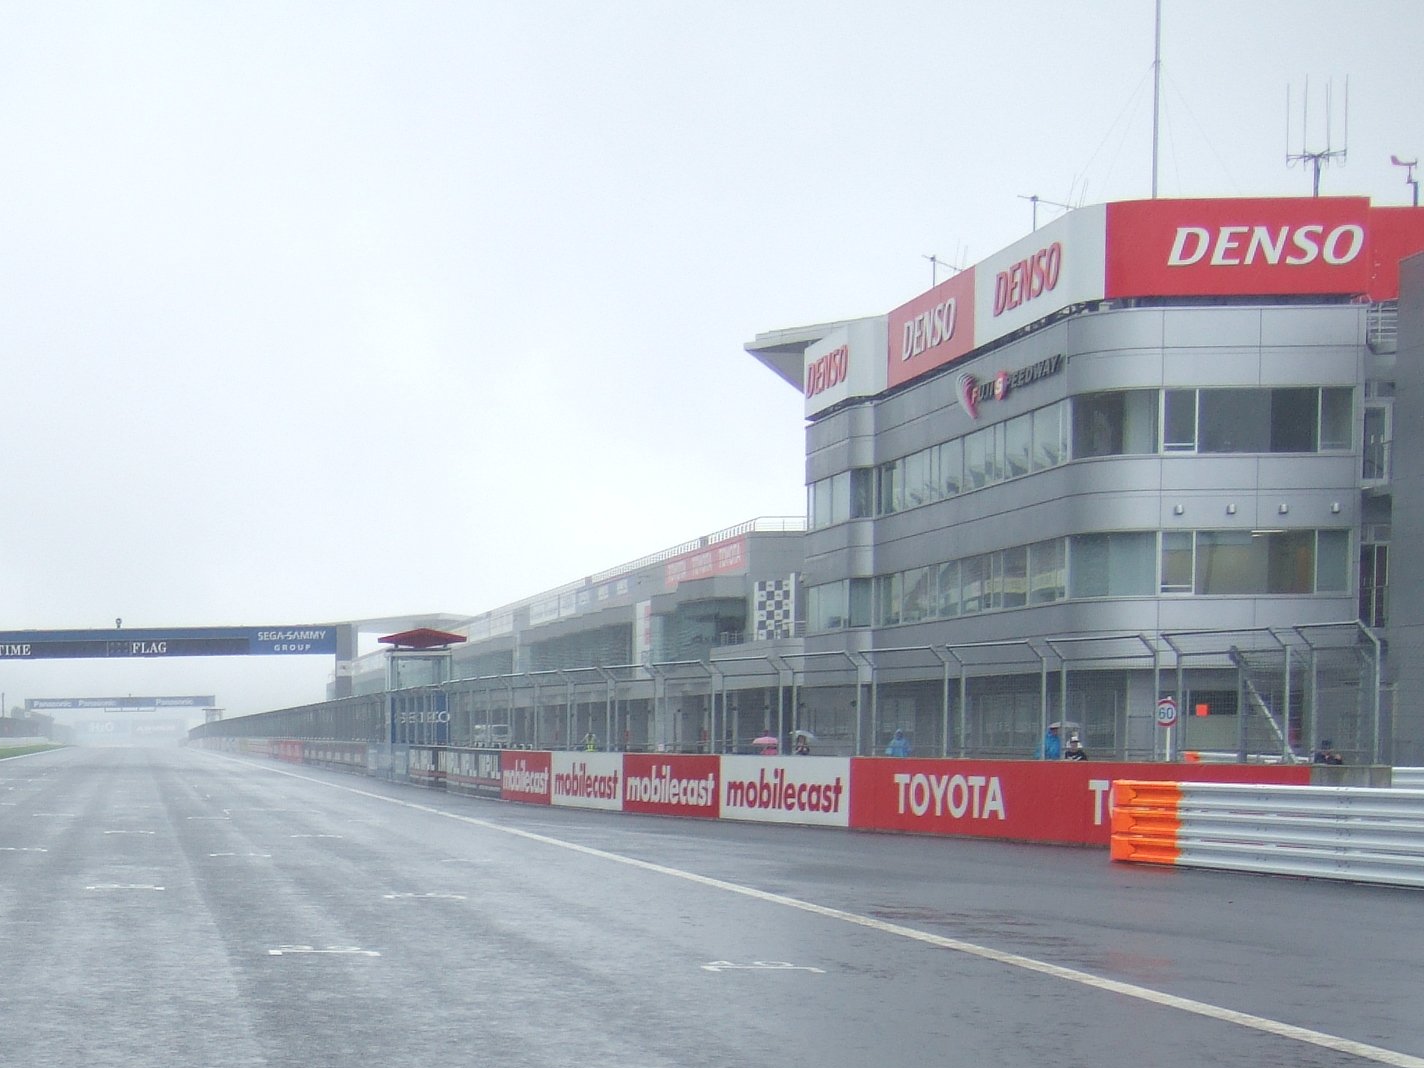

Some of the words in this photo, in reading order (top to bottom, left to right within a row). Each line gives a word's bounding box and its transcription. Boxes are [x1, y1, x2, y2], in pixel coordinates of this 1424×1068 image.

[1166, 223, 1365, 267] DENSO
[993, 241, 1063, 318] DENSO
[901, 296, 958, 363] DENSO
[805, 344, 849, 400] DENSO
[132, 641, 167, 654] FLAG
[1158, 706, 1175, 721] 60
[502, 759, 550, 796] mobilecast
[555, 762, 619, 800] mobilecast
[626, 765, 715, 807] mobilecast
[726, 768, 843, 814] mobilecast
[894, 773, 1007, 821] TOYOTA
[1088, 779, 1113, 826] T
